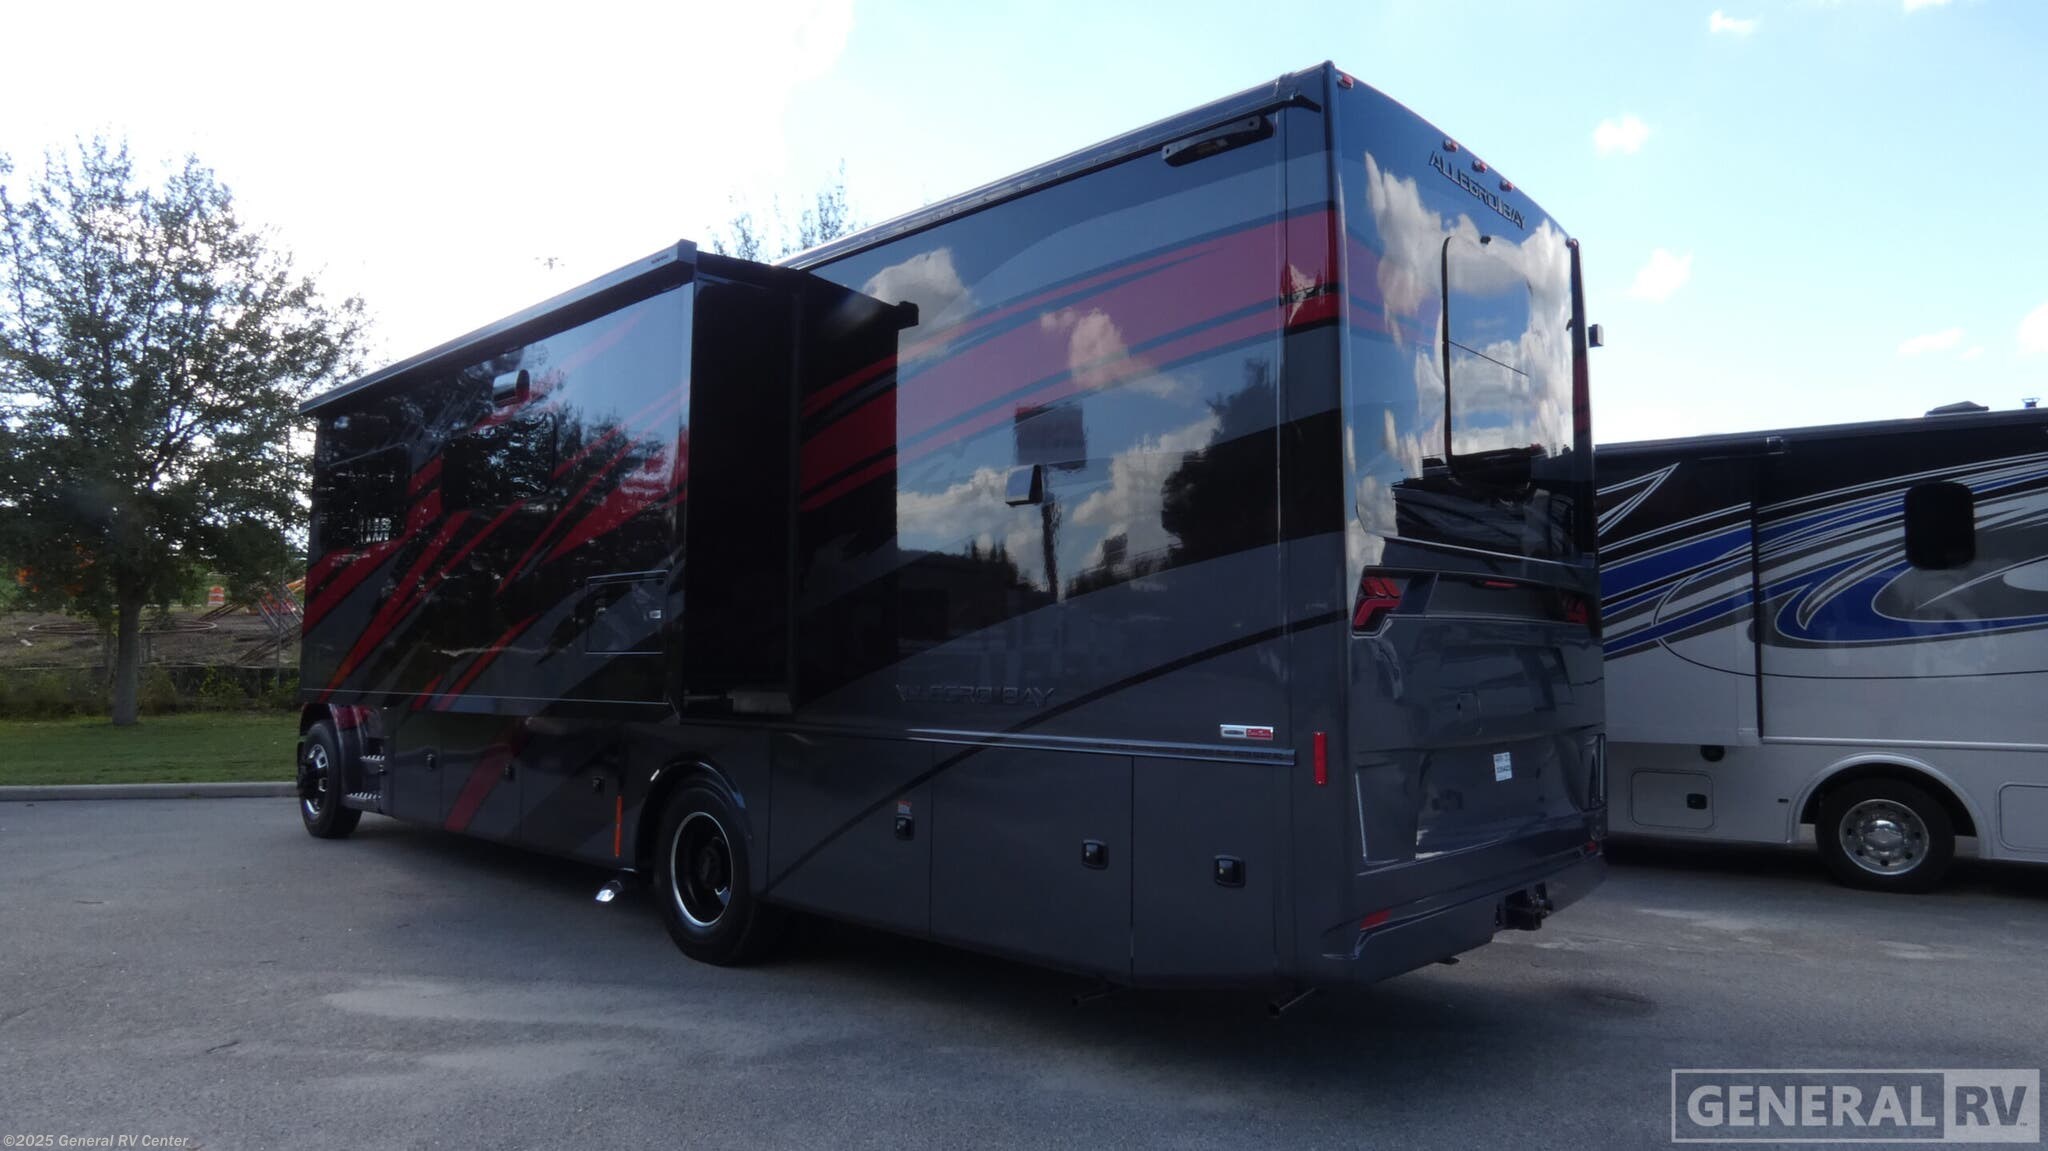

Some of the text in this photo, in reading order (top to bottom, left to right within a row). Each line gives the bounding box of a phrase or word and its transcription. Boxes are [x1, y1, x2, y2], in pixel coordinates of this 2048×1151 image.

[1429, 151, 1525, 230] ALLEGRO BAY
[1002, 686, 1056, 708] BAY
